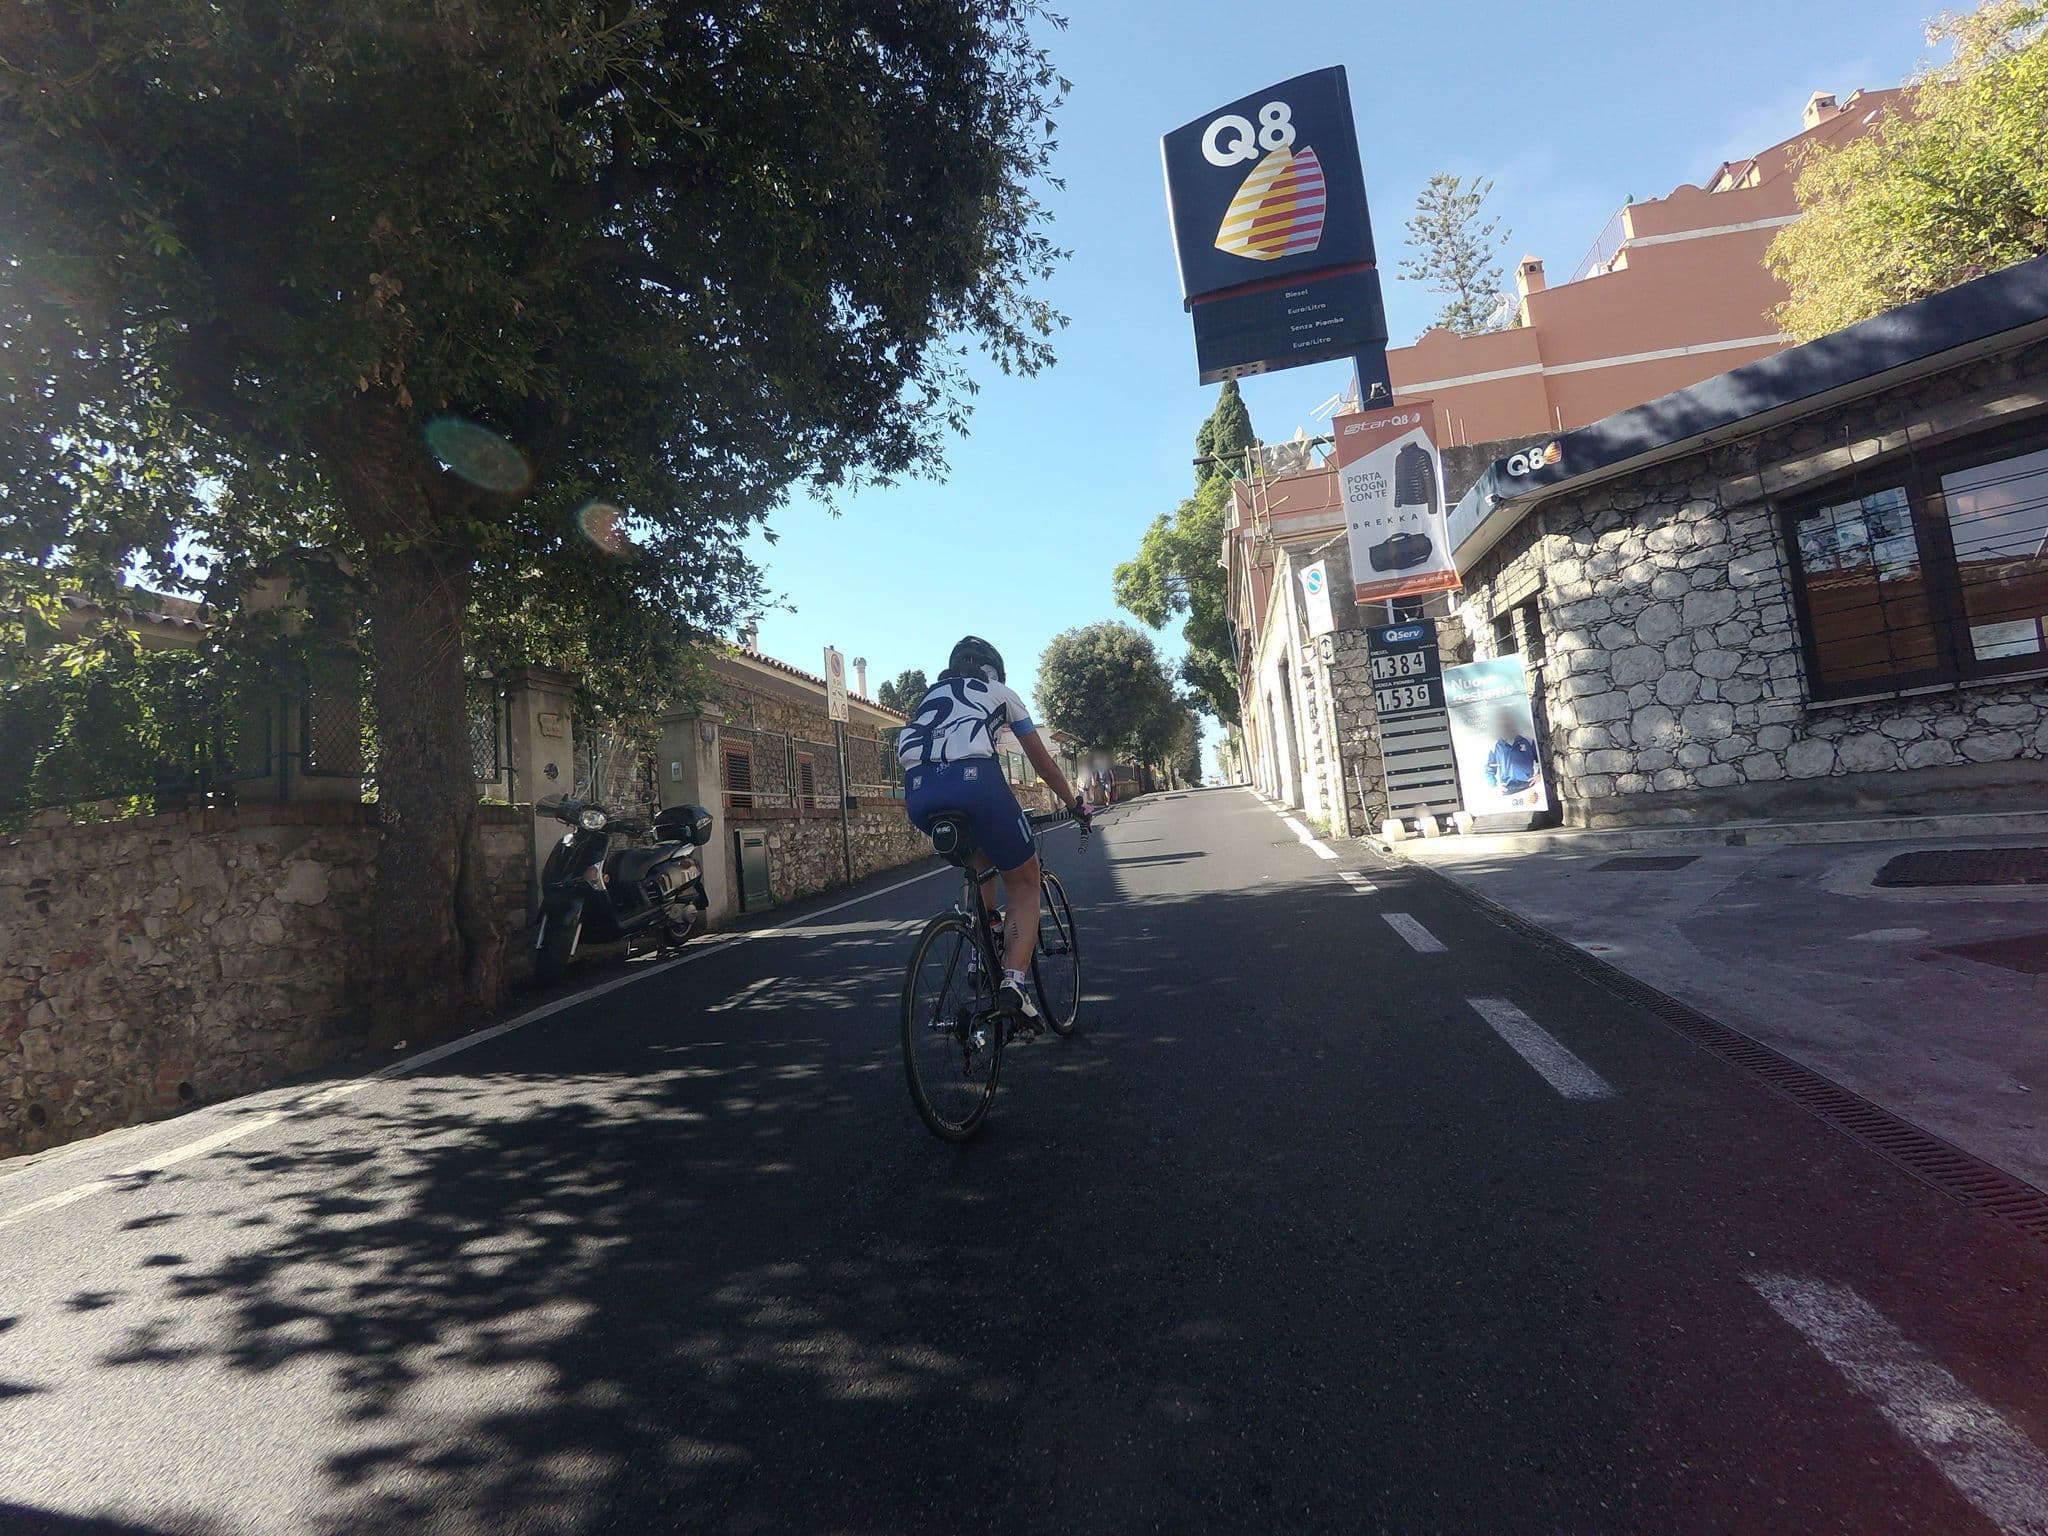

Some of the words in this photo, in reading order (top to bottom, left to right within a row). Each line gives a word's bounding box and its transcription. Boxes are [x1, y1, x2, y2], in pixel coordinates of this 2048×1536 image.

[1202, 101, 1296, 167] Q8
[1285, 288, 1308, 298] Diesel
[1287, 303, 1326, 315] Euro/Litro
[1290, 323, 1313, 332] Senza
[1292, 337, 1332, 348] Euro/Litro
[1506, 447, 1545, 477] Q8
[1347, 471, 1382, 485] PORTA
[1348, 486, 1352, 494] I
[1354, 479, 1388, 493] SOGNI
[1350, 492, 1372, 503] CON
[1374, 489, 1388, 498] TE
[1353, 513, 1419, 530] BREKKA
[1373, 653, 1423, 679] 1,384
[1450, 675, 1498, 691] Nuo
[1377, 686, 1426, 711] 1,536
